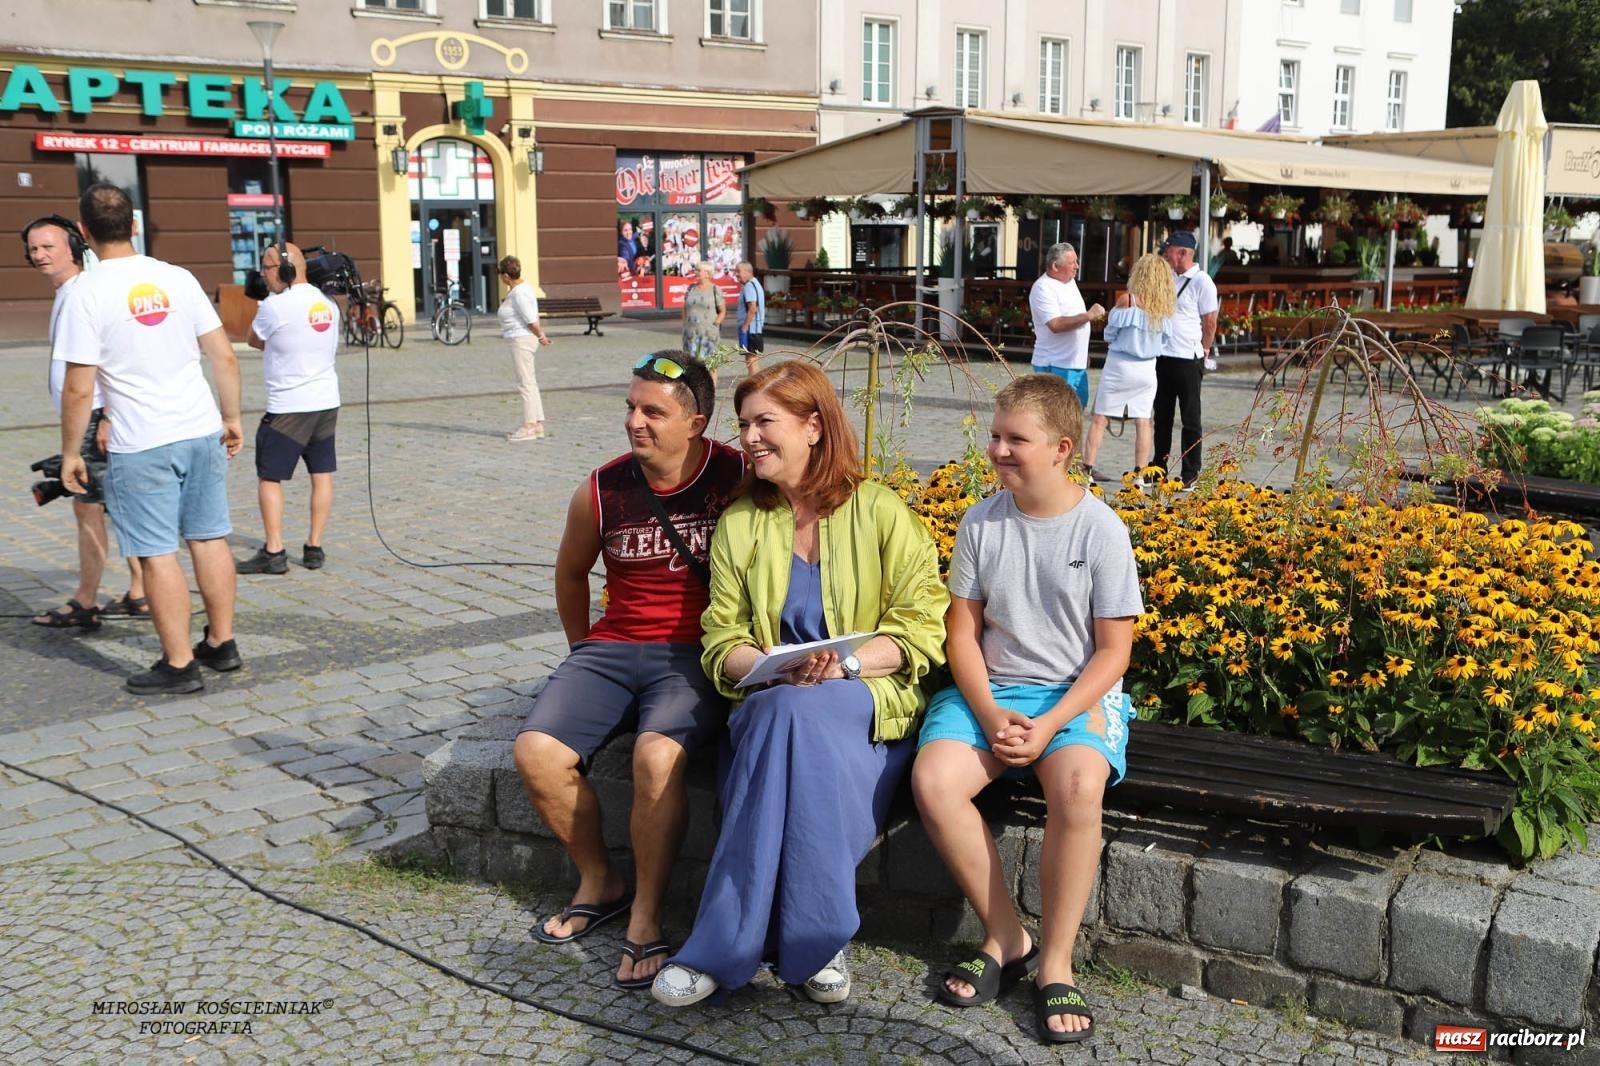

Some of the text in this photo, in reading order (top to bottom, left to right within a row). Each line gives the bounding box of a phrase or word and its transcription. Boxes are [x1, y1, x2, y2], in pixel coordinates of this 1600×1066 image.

[0, 63, 353, 124] APTEKA
[241, 124, 350, 138] POD RÓŻAMI
[43, 136, 96, 149] RYNEK
[100, 138, 119, 150] 12
[129, 138, 201, 153] CENTRUM
[1046, 996, 1087, 1008] KUBOTA
